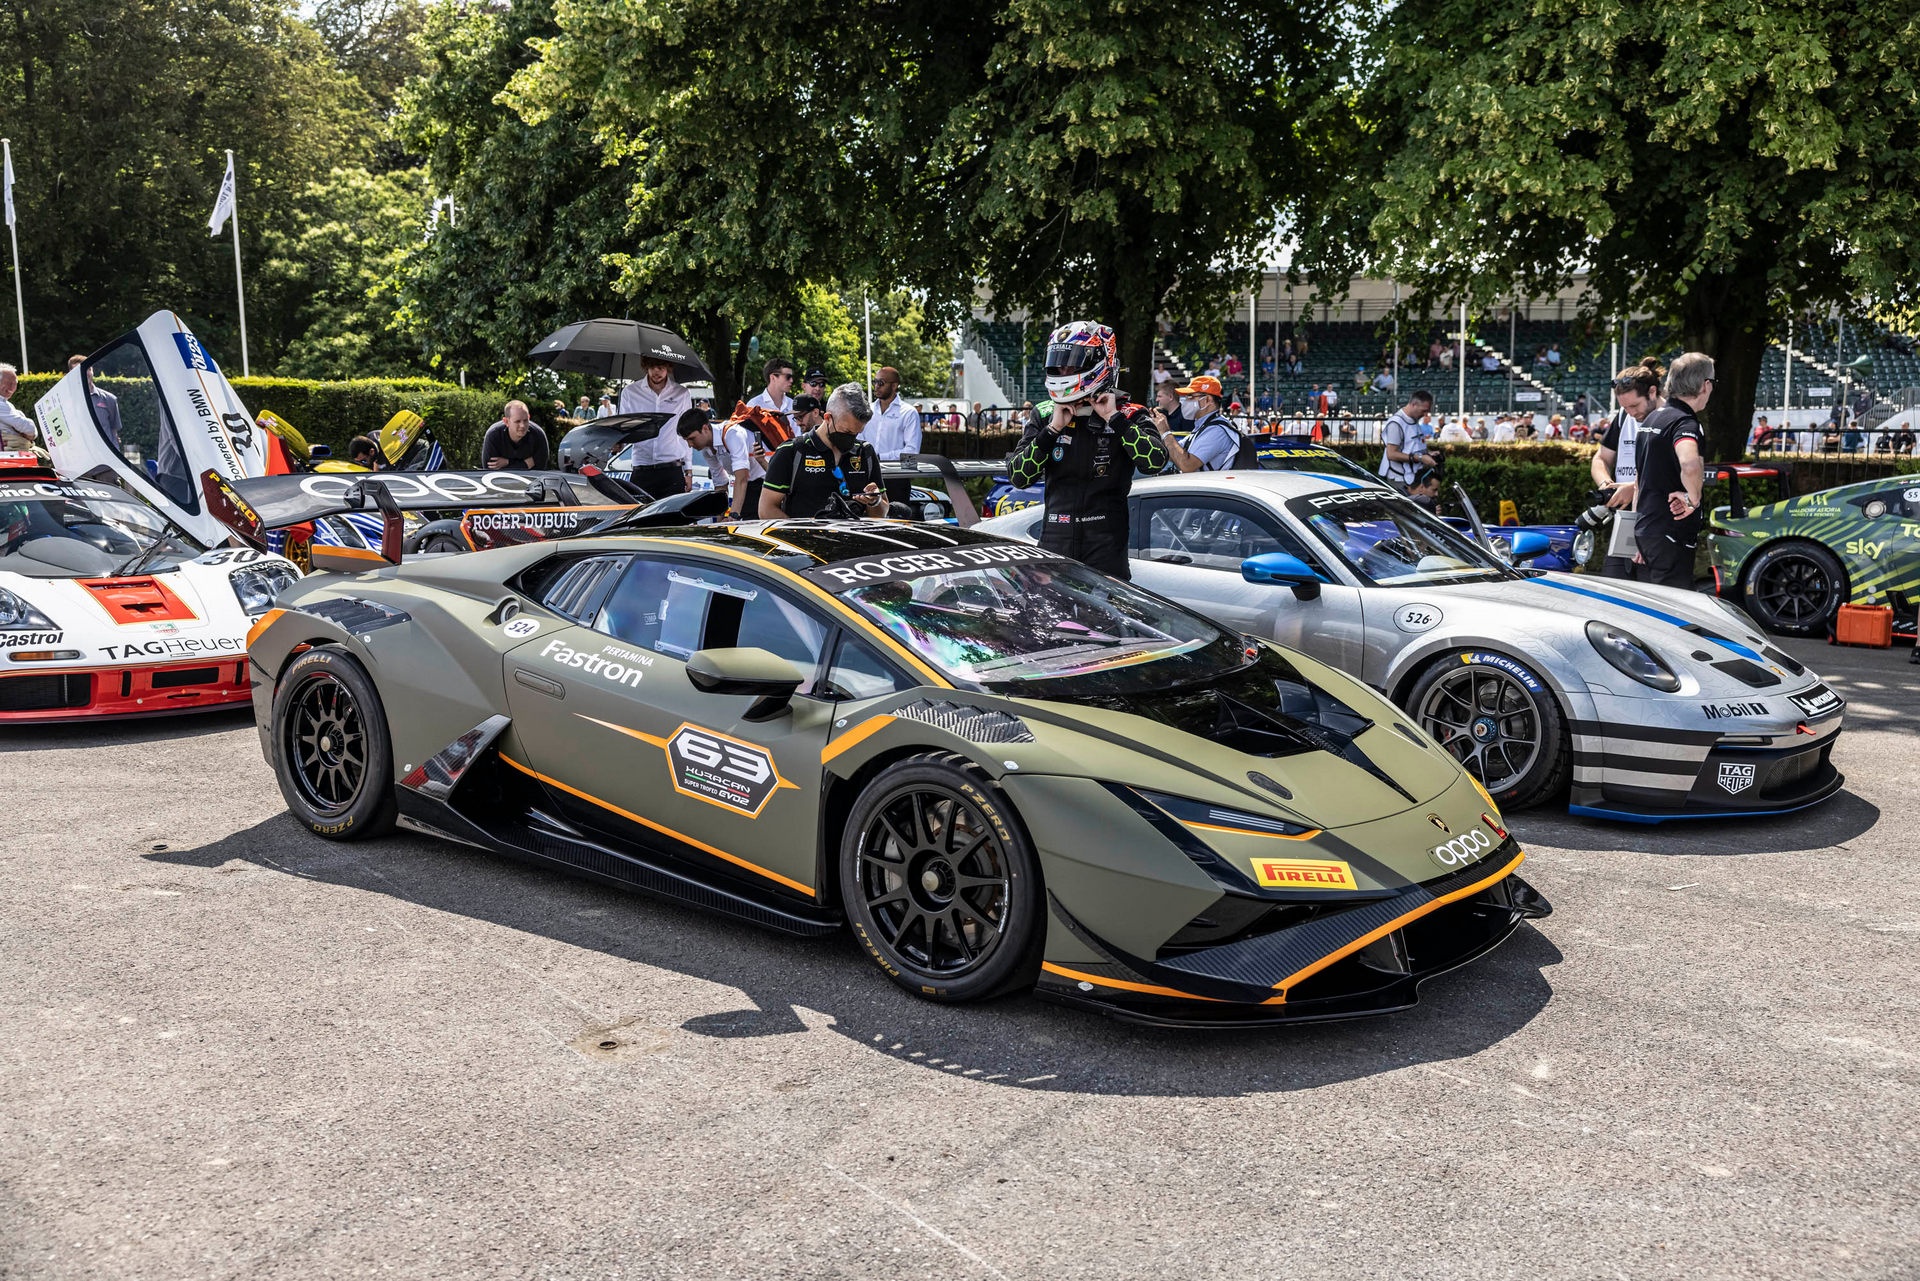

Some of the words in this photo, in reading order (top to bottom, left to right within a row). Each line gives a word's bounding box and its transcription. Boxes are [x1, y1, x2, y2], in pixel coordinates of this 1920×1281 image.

[187, 388, 211, 417] BMW
[54, 424, 63, 437] GT
[206, 420, 219, 434] by
[209, 472, 221, 483] P
[220, 483, 258, 522] ZERO
[473, 514, 521, 530] ROGER
[523, 512, 578, 529] DUBUIS
[202, 549, 261, 566] 30
[1845, 538, 1886, 560] sky
[822, 552, 966, 584] ROGER
[508, 621, 535, 635] 524
[1405, 612, 1430, 625] 526
[0, 631, 64, 648] Castrol
[291, 654, 332, 675] PIRELLI
[540, 639, 643, 688] Fastron
[602, 645, 654, 667] PERTAMINA
[1482, 655, 1538, 689] MICHELIN
[1701, 702, 1752, 720] Mobil
[676, 731, 770, 785] 63
[1722, 765, 1752, 776] TAG
[684, 778, 699, 789] SUPER
[700, 784, 718, 795] TROFEO
[718, 790, 750, 806] EVO2
[1720, 776, 1751, 792] HEUER
[313, 822, 345, 835] ZERO
[971, 795, 1011, 842] ZERO
[1435, 829, 1490, 865] oppo
[1262, 863, 1346, 884] PIRELLI
[856, 922, 900, 977] PIRELLI
